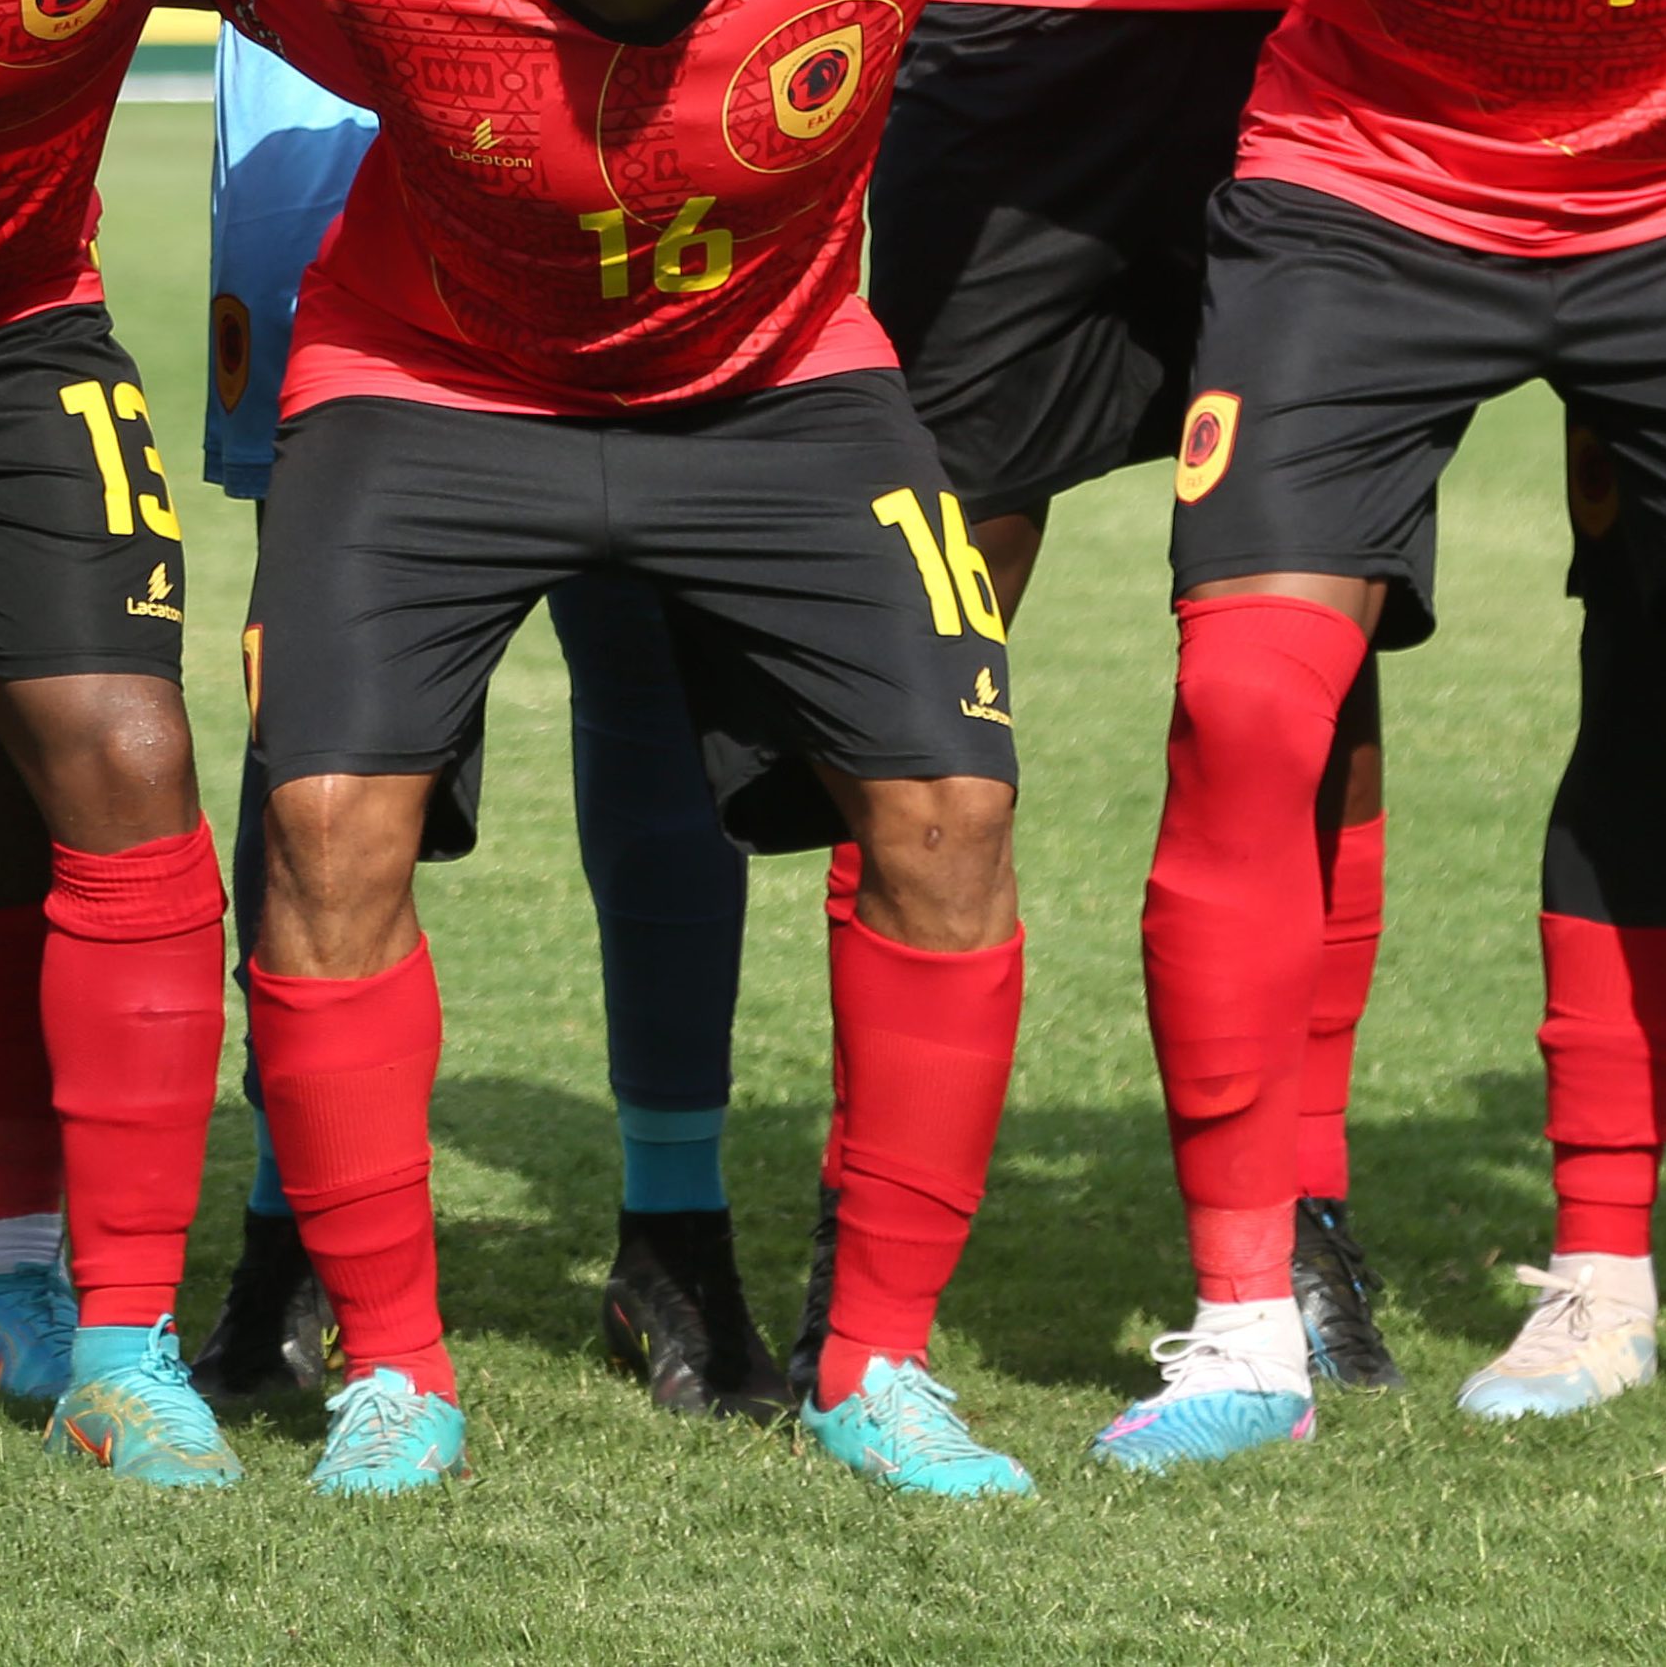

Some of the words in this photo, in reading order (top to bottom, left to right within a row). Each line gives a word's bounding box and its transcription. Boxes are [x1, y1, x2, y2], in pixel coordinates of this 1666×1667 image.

[449, 145, 533, 169] Lacatoni
[580, 196, 734, 299] 16
[58, 379, 184, 543] 13
[869, 487, 1010, 646] 16
